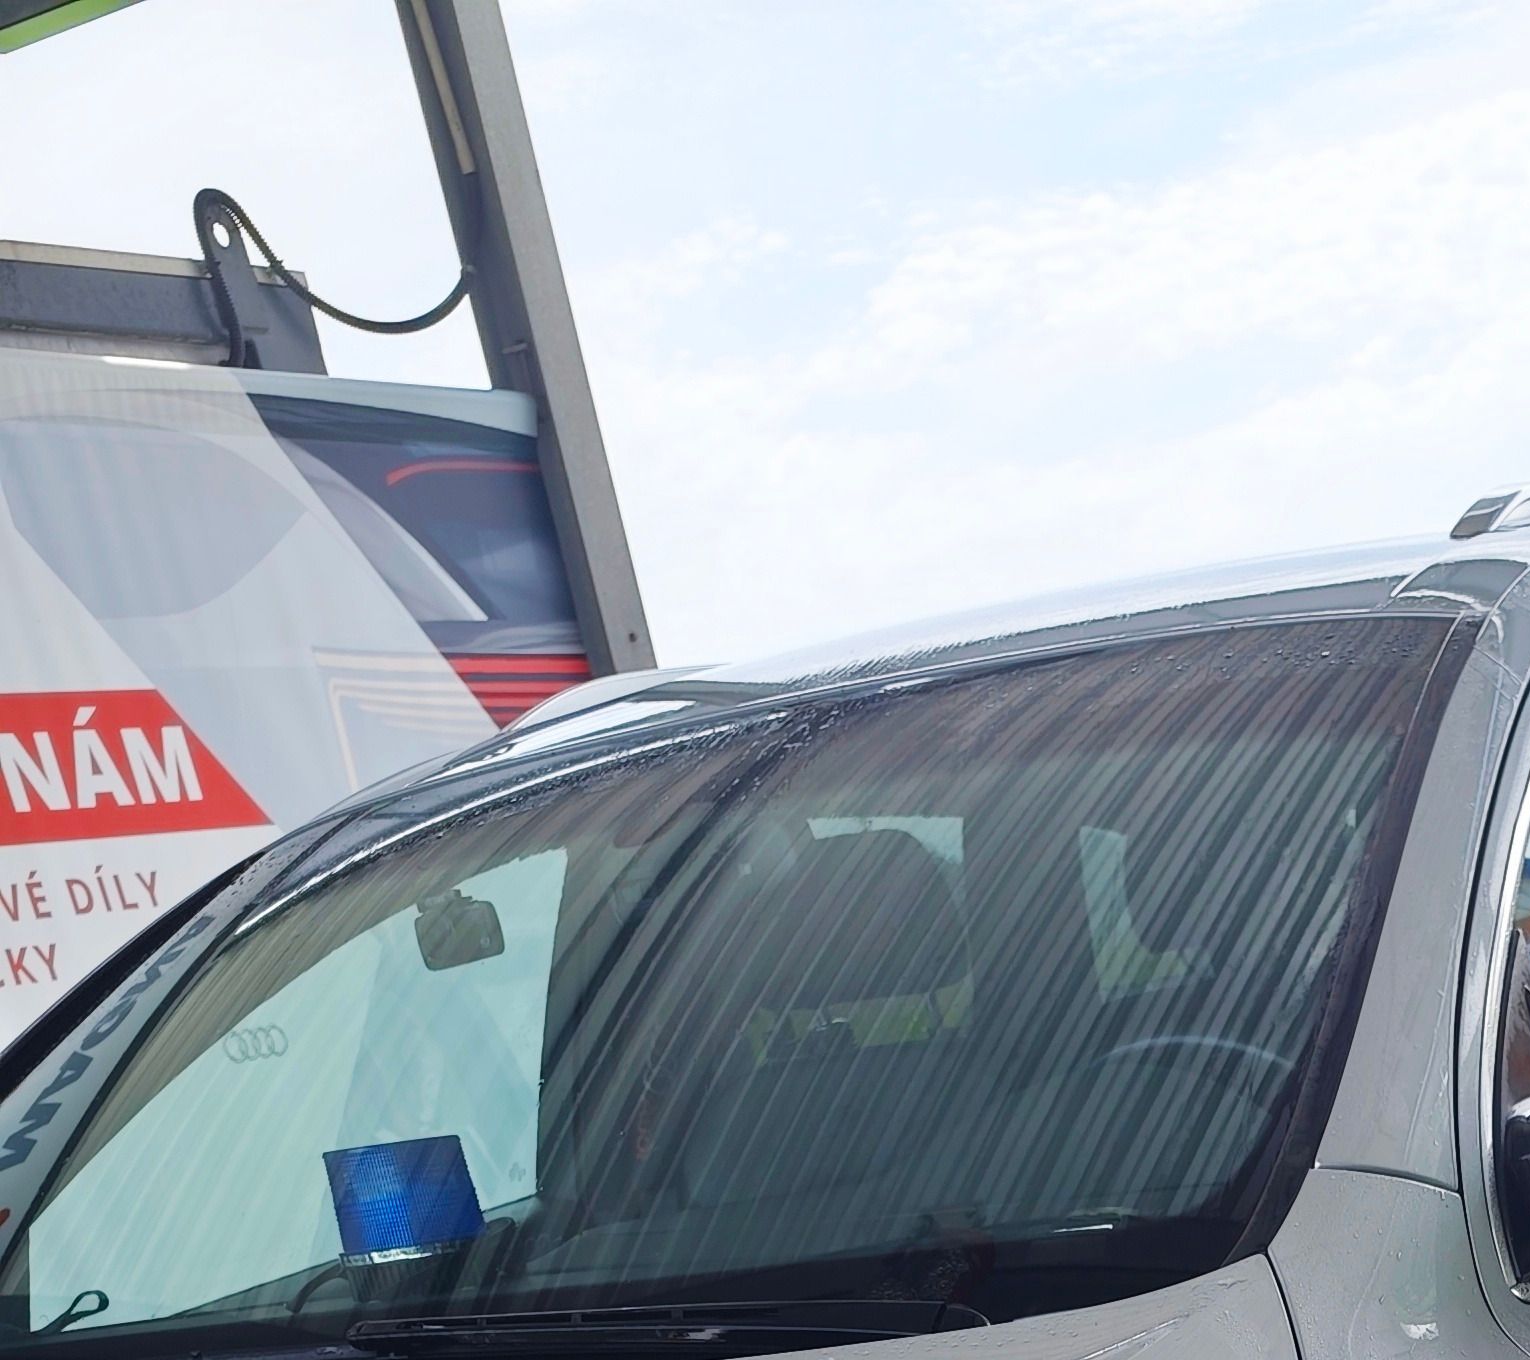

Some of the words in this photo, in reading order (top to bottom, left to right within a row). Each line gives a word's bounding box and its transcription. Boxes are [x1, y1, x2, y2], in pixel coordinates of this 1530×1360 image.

[0, 706, 203, 813] NÁM
[65, 864, 159, 916] DÍLY
[0, 943, 58, 988] KY
